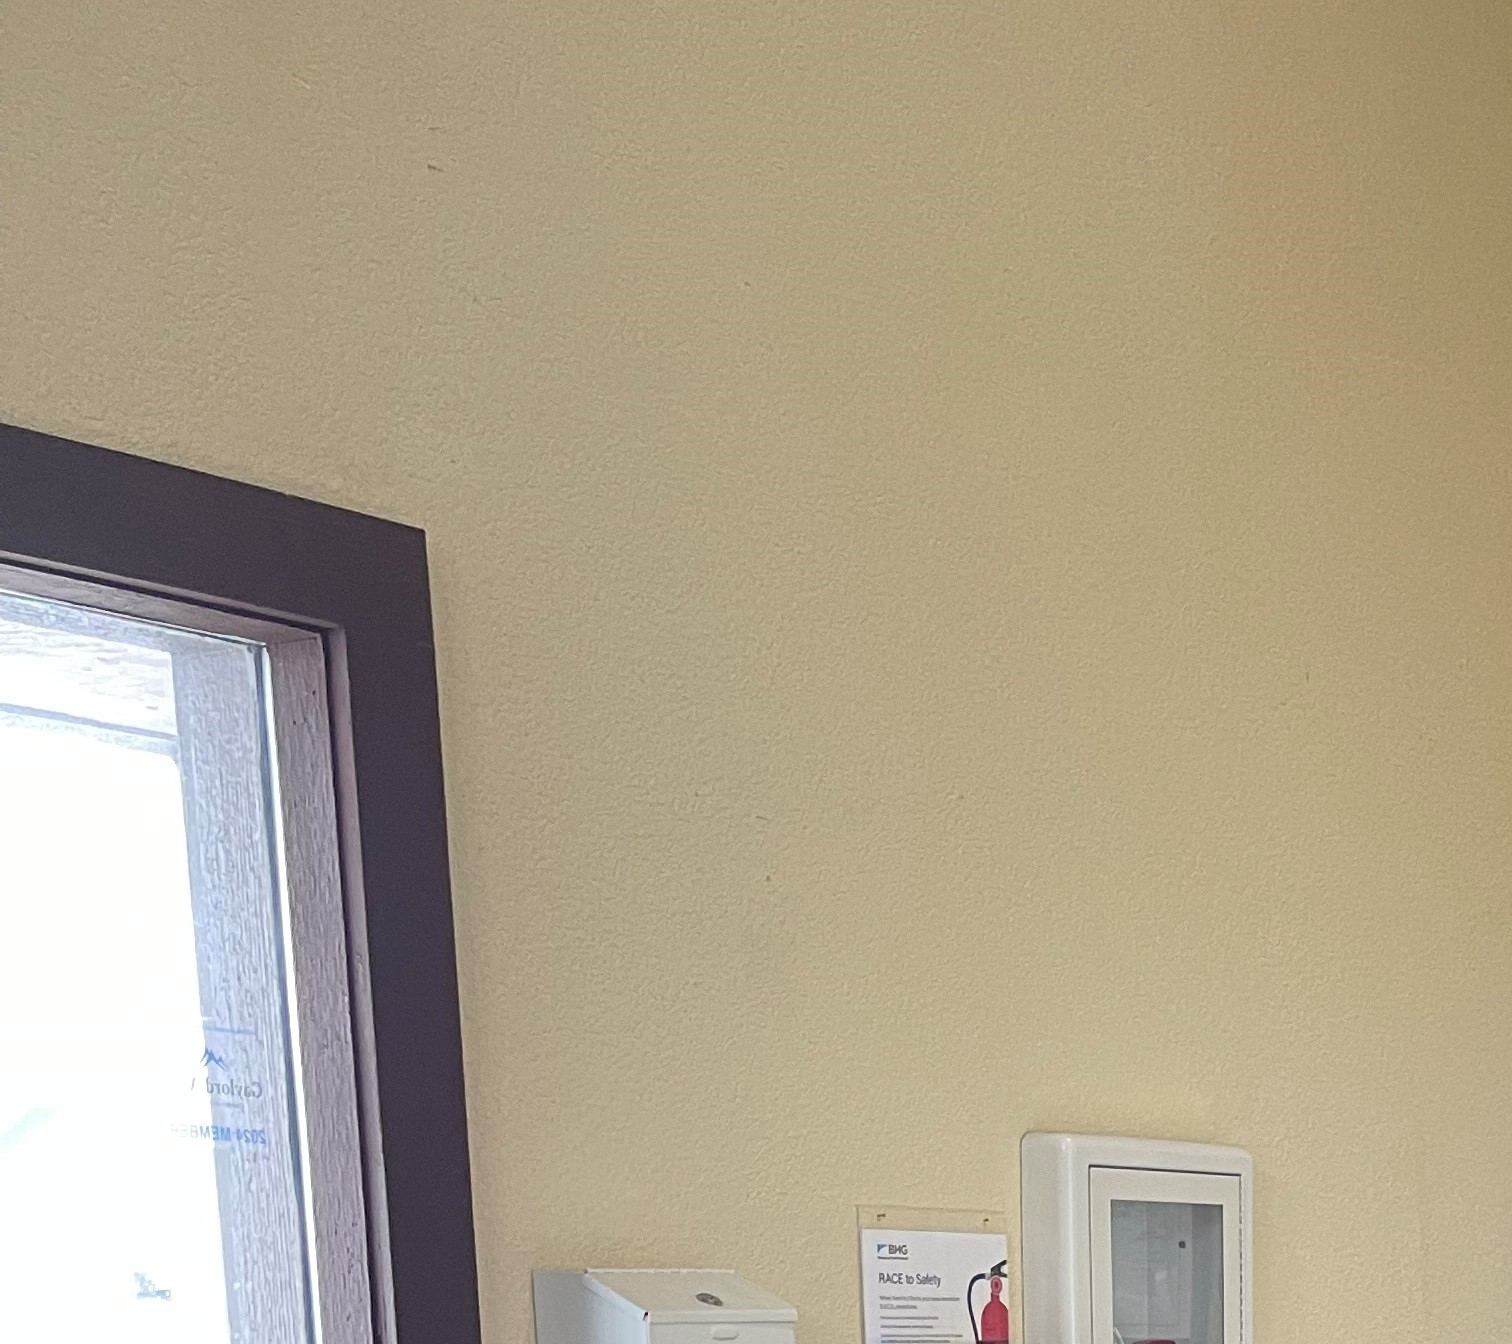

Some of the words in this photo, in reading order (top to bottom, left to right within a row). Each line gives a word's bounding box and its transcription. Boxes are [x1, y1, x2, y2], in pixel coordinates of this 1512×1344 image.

[888, 1244, 908, 1256] BHG
[878, 1273, 903, 1284] RACE
[905, 1273, 915, 1285] to
[916, 1273, 942, 1288] Safety
